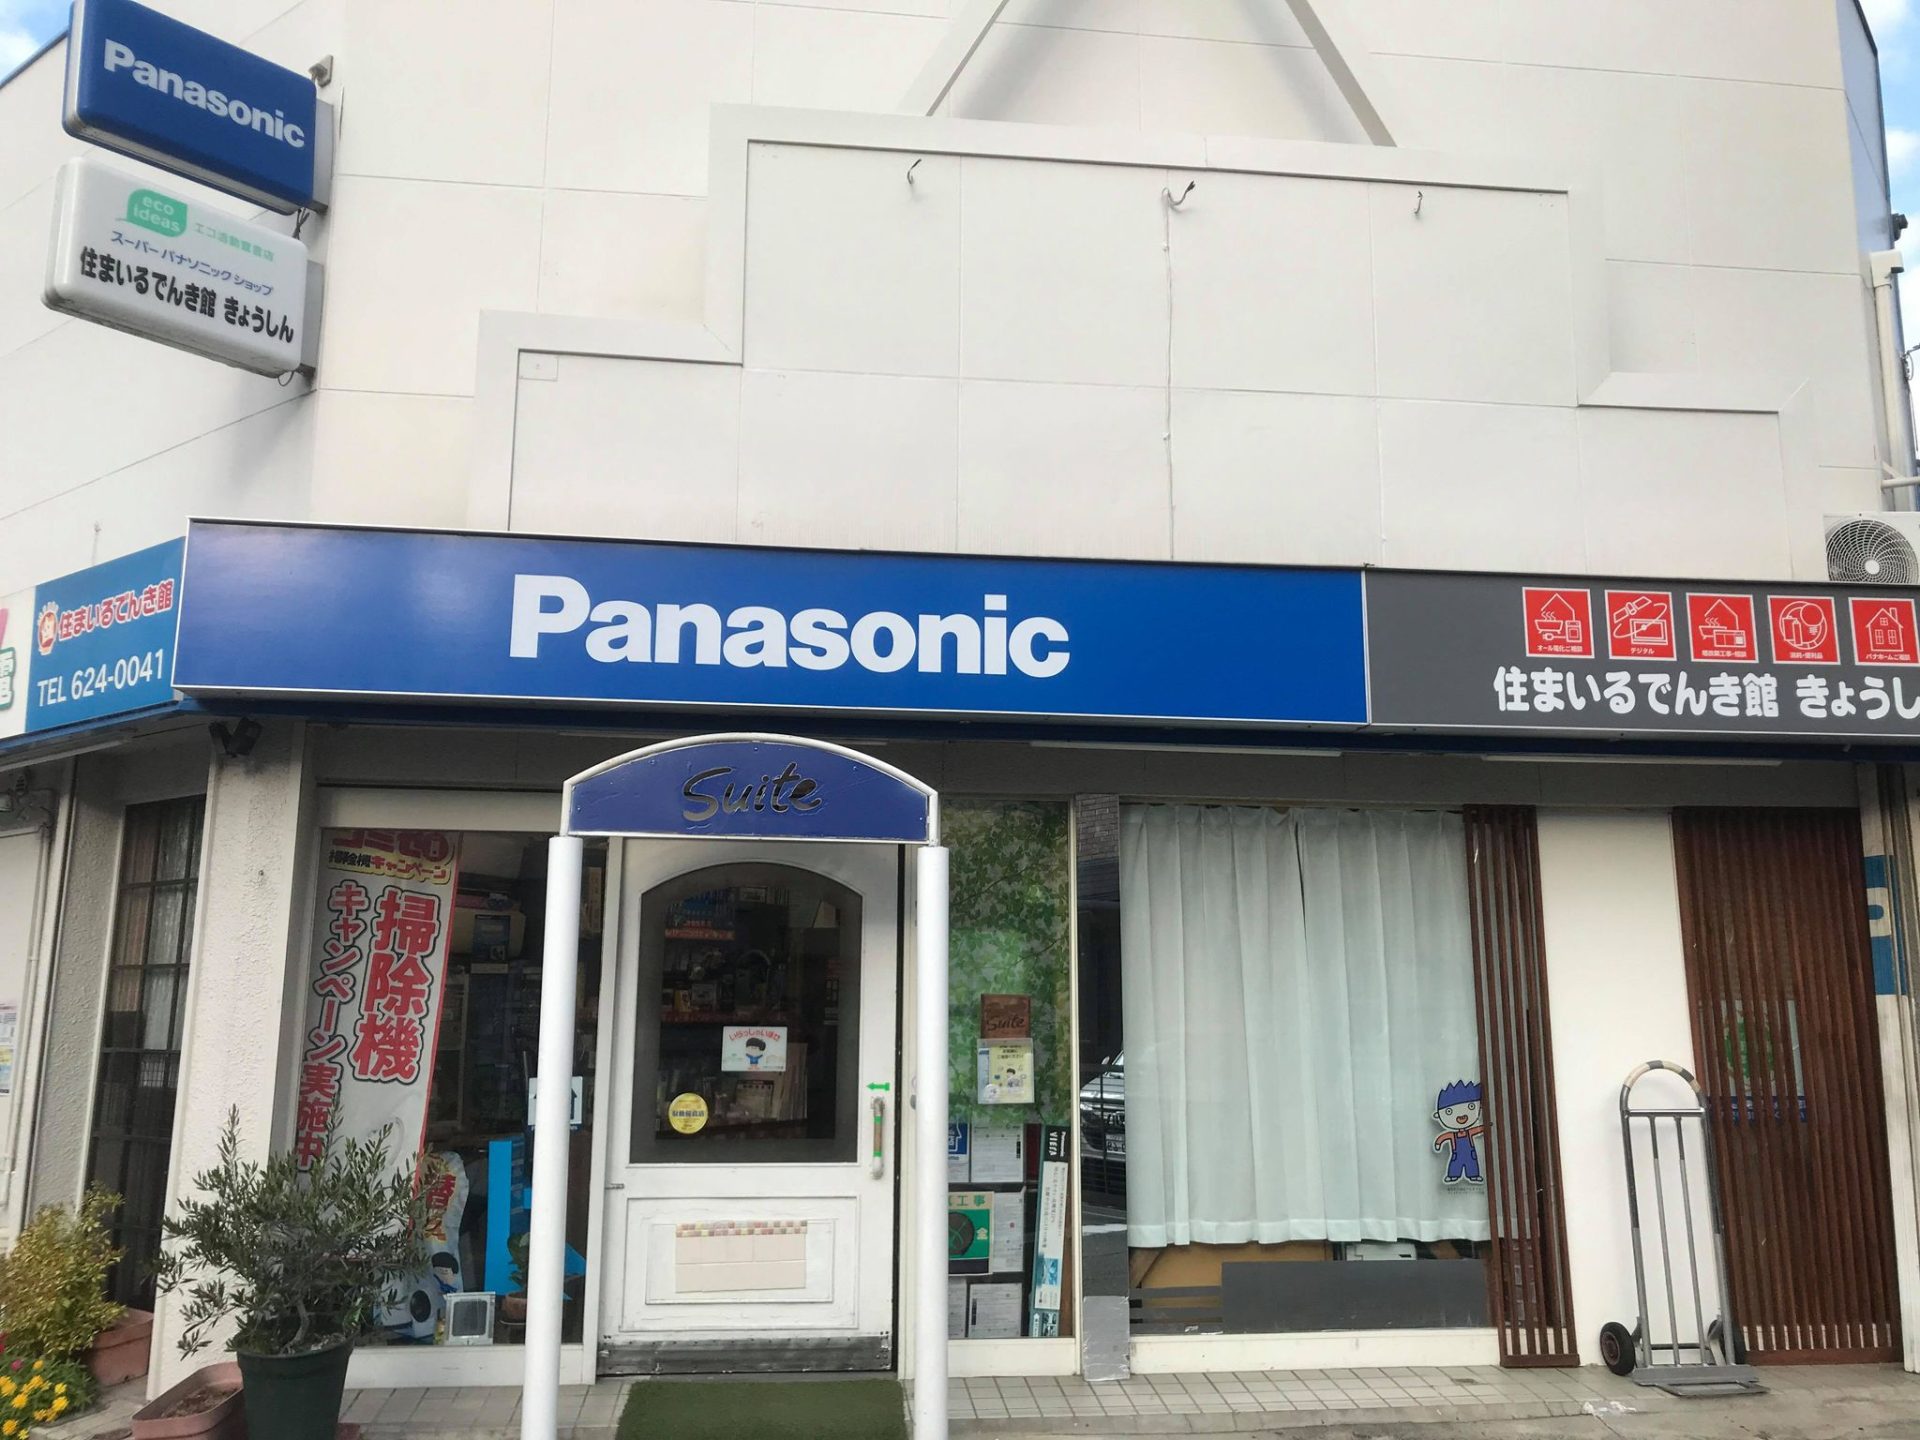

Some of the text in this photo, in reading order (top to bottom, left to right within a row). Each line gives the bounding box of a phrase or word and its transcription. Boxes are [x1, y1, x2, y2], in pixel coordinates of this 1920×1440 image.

[104, 38, 305, 148] Panasonic
[133, 203, 181, 233] ideas
[142, 196, 175, 214] eco
[80, 246, 294, 344] 住まいるでんき館 きょうしん
[58, 578, 174, 641] 住まいるでんき館
[509, 573, 1071, 678] Panasonic
[37, 675, 67, 707] TEL
[71, 648, 164, 700] 624-0041
[1630, 646, 1655, 655] デジタル
[1493, 665, 1779, 718] 住まいるでんき館
[682, 762, 822, 822] Suite
[352, 888, 436, 1080] 掃除機
[299, 884, 367, 1167] キャンペーン実施中
[987, 1014, 1025, 1032] Suite
